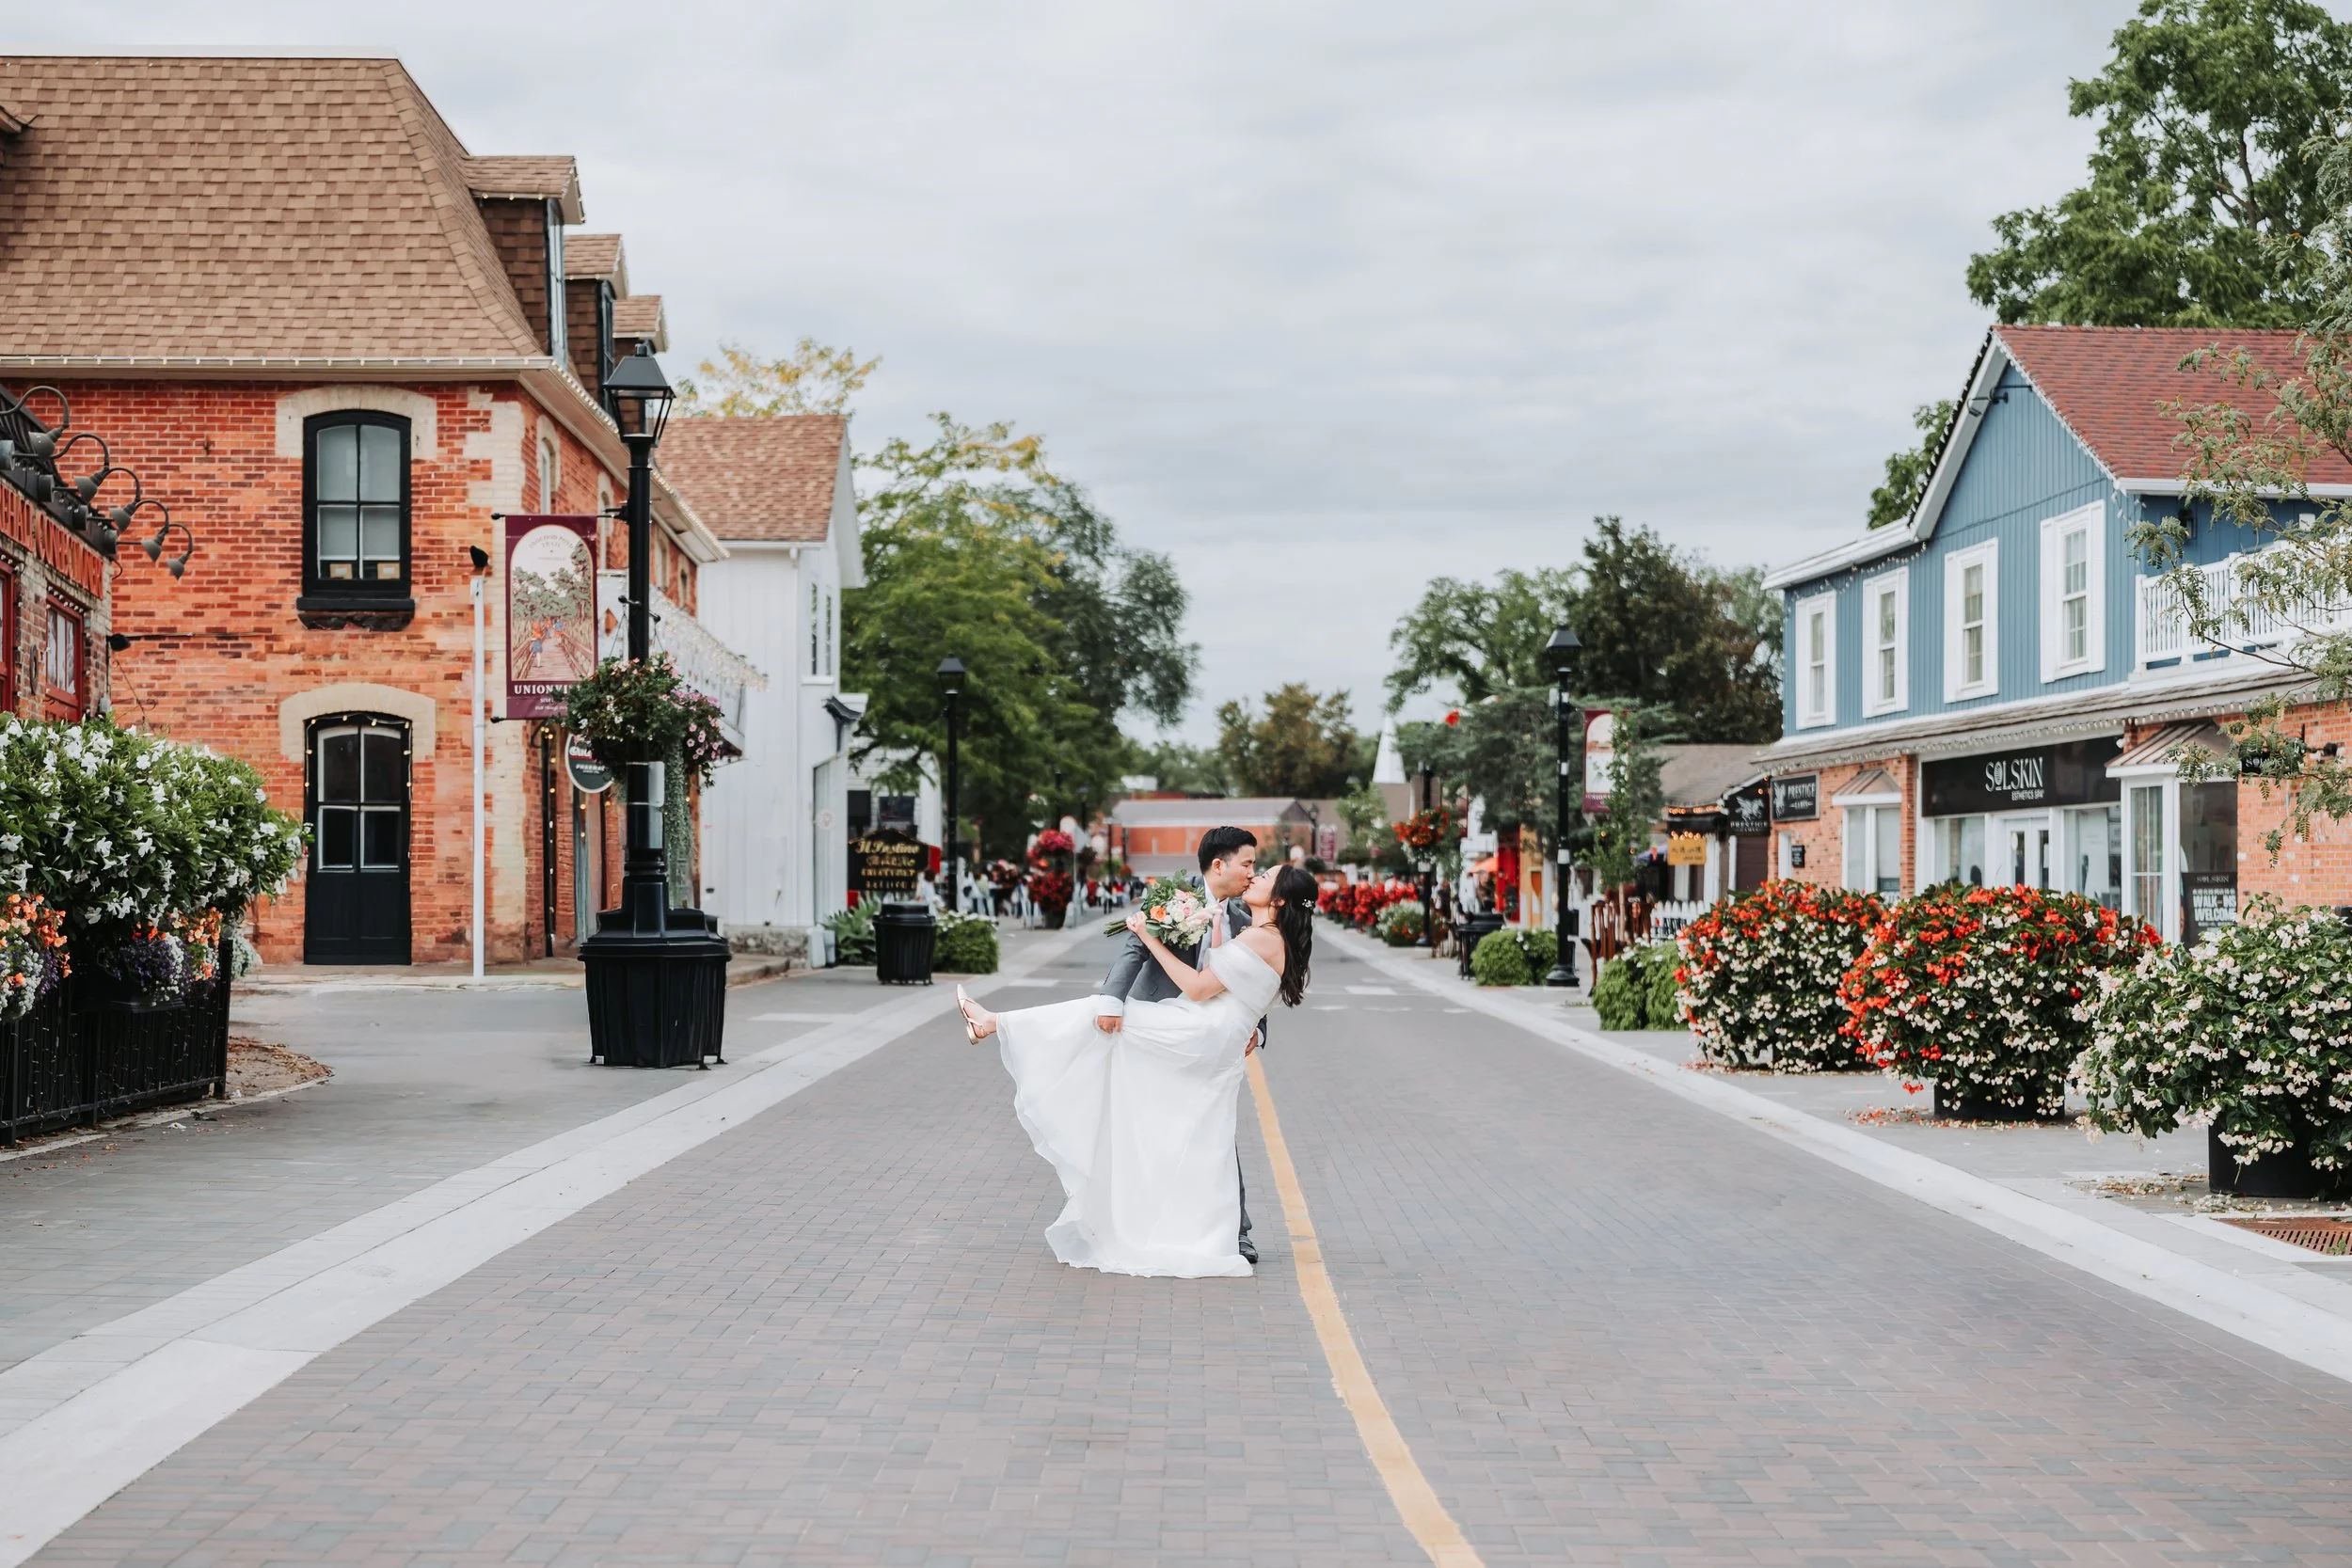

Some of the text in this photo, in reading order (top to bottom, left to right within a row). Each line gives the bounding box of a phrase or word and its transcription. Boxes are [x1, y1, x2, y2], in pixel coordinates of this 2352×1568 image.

[514, 684, 574, 695] UNIONVI
[1788, 783, 1815, 800] PRESTIGE
[2194, 907, 2237, 922] WELCOME
